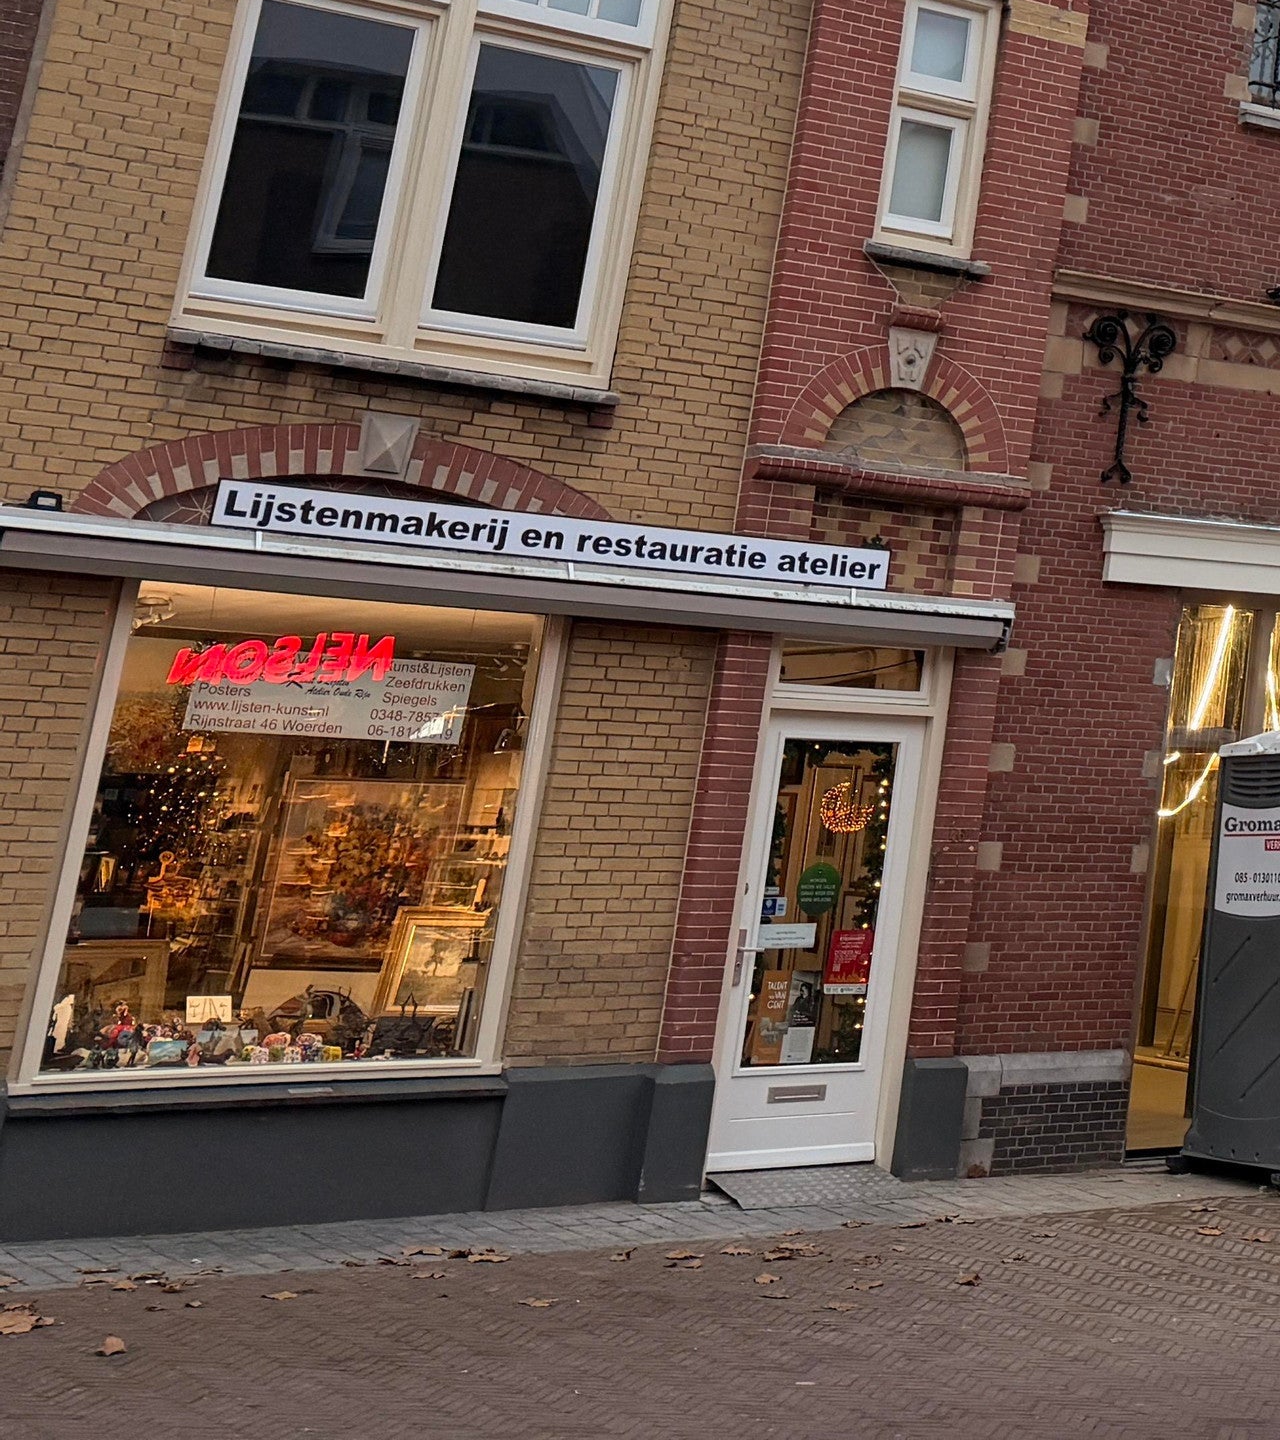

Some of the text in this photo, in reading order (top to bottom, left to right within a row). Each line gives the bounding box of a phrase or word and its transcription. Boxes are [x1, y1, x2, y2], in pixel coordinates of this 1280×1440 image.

[223, 489, 882, 580] Lijstenmakerij en restauratie atelier
[388, 662, 471, 678] unst&Lijsten
[198, 682, 251, 697] Posters
[386, 676, 465, 692] Zeefdrukken
[382, 692, 437, 707] Spiegels
[190, 714, 343, 734] Rijnstraat 46 Woerden
[1234, 872, 1248, 883] 085
